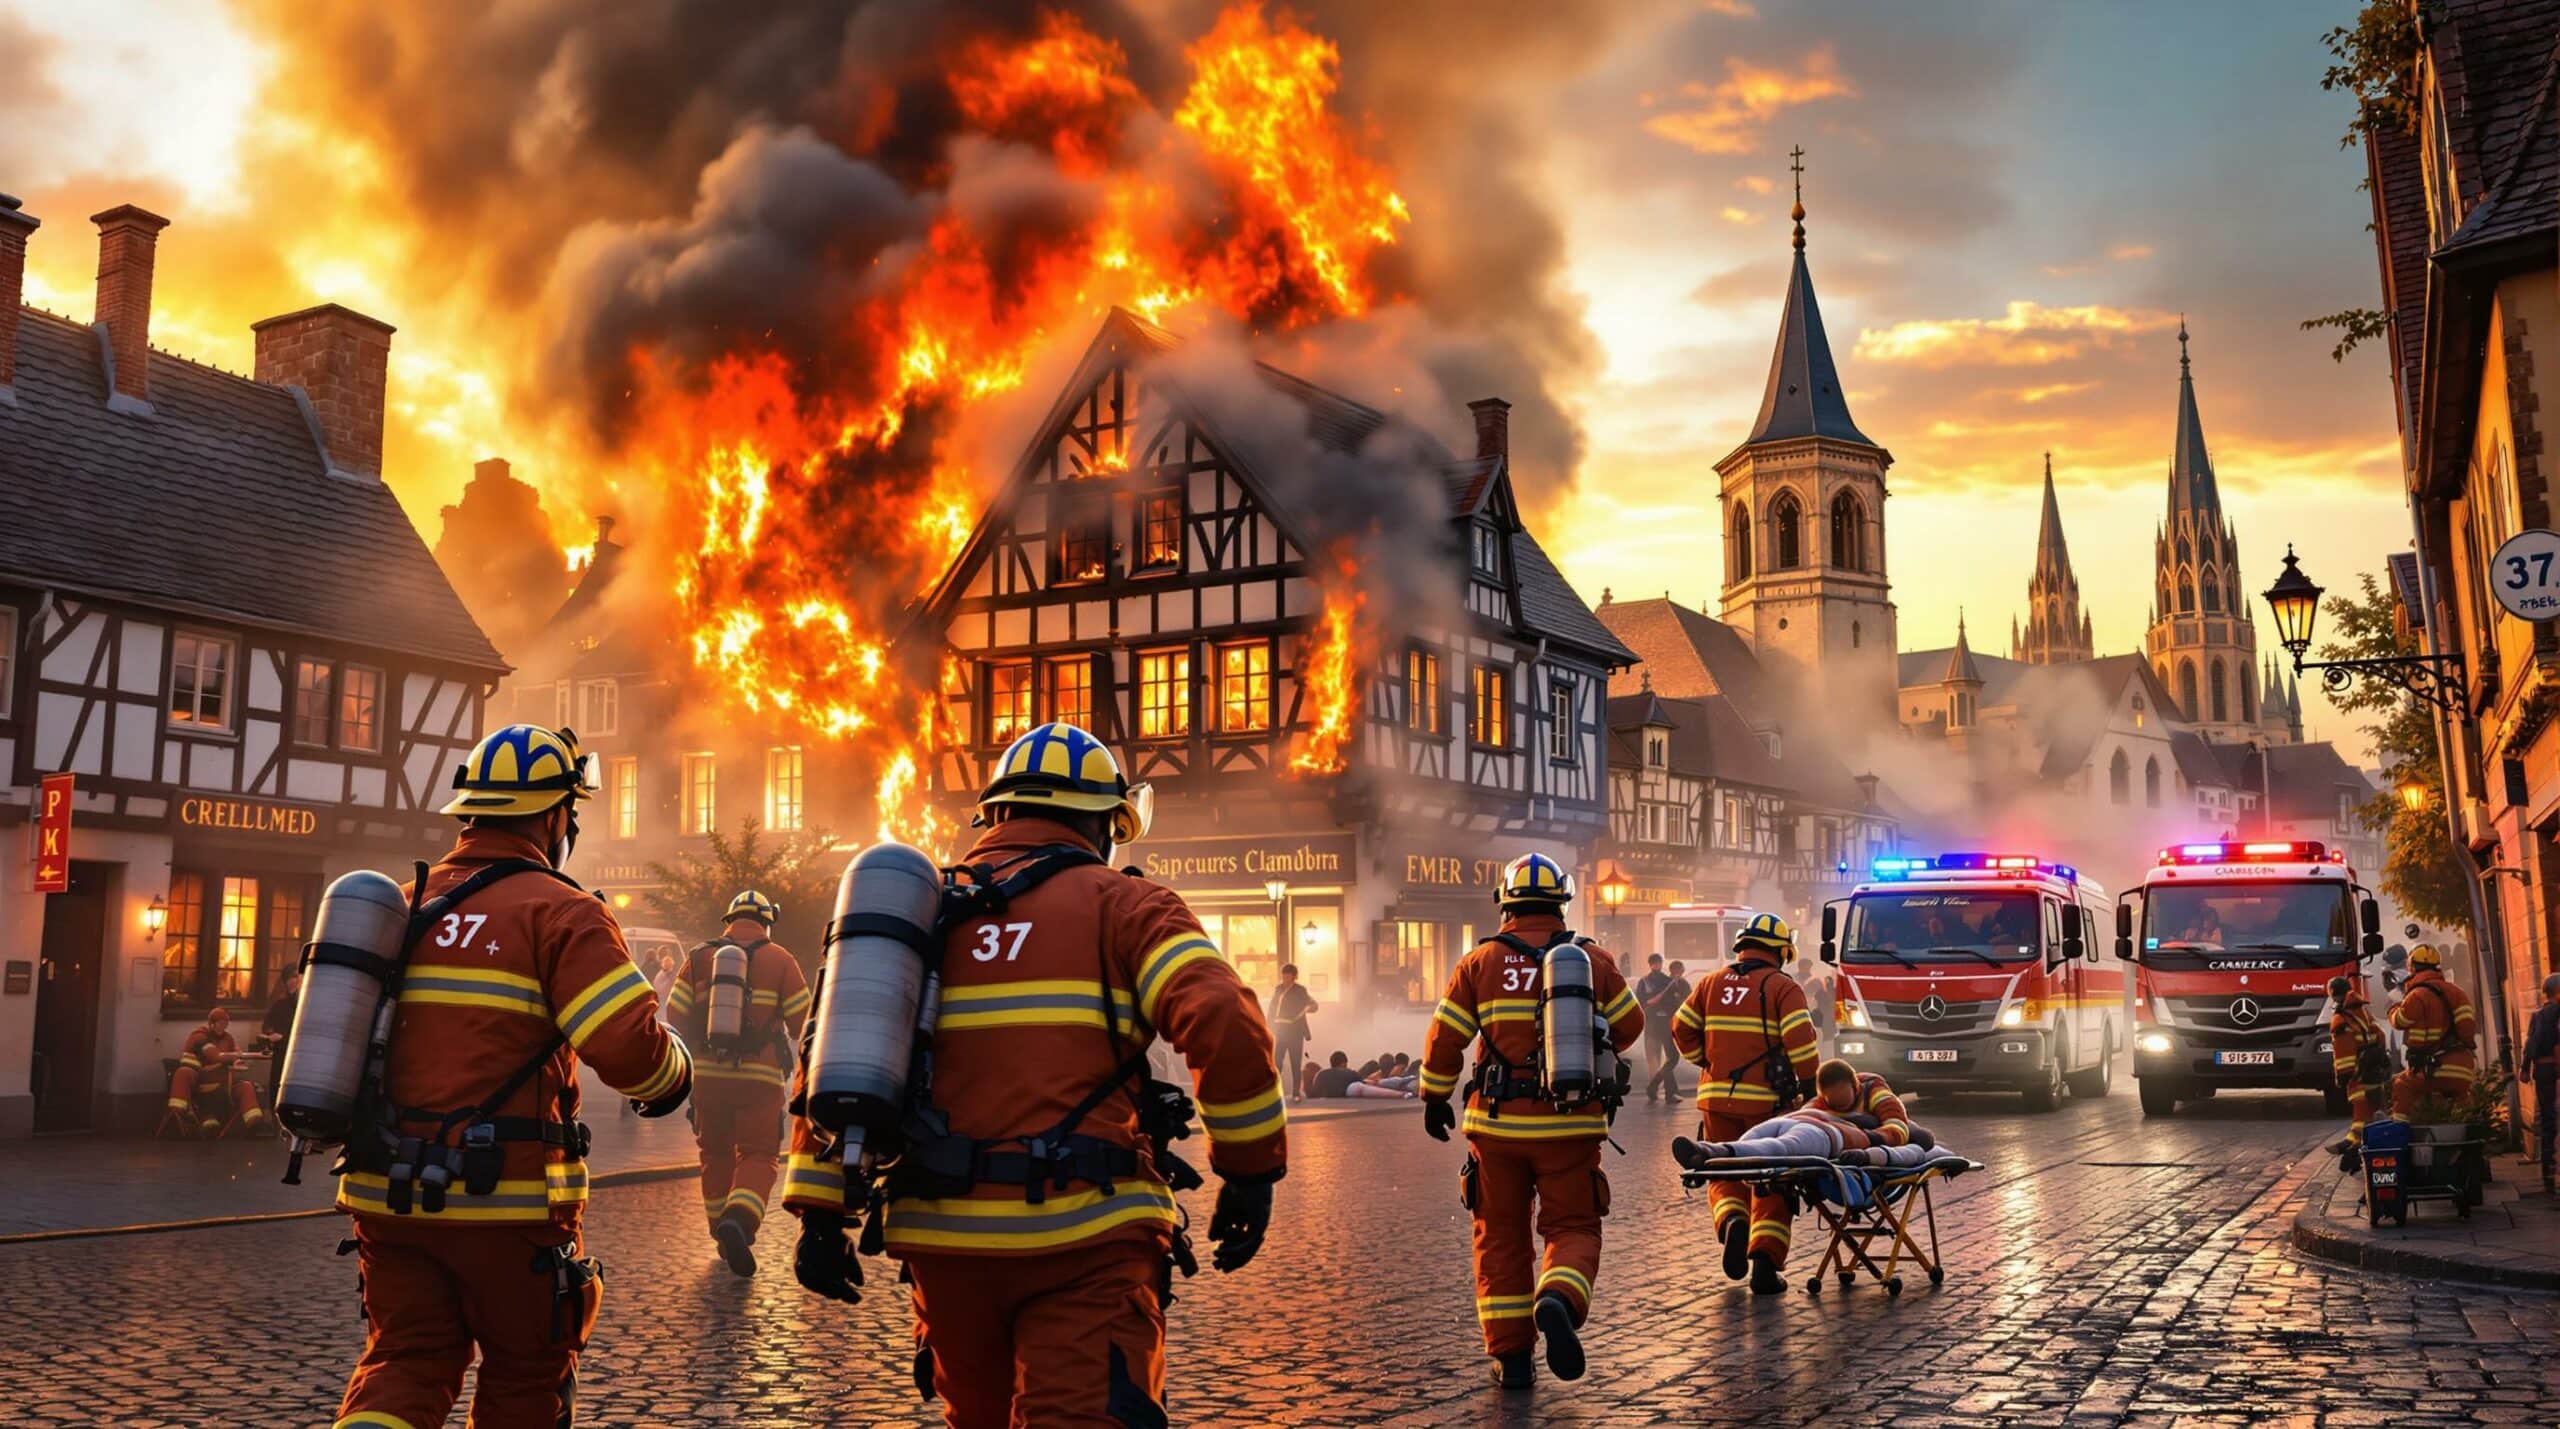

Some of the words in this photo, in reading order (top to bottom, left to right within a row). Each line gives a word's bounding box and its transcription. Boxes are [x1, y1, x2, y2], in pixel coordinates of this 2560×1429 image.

[181, 799, 316, 834] CRELLLMED
[1407, 855, 1462, 884] EMER
[972, 921, 1033, 962] 37
[1502, 967, 1538, 991] 37
[1721, 986, 1750, 1005] 37
